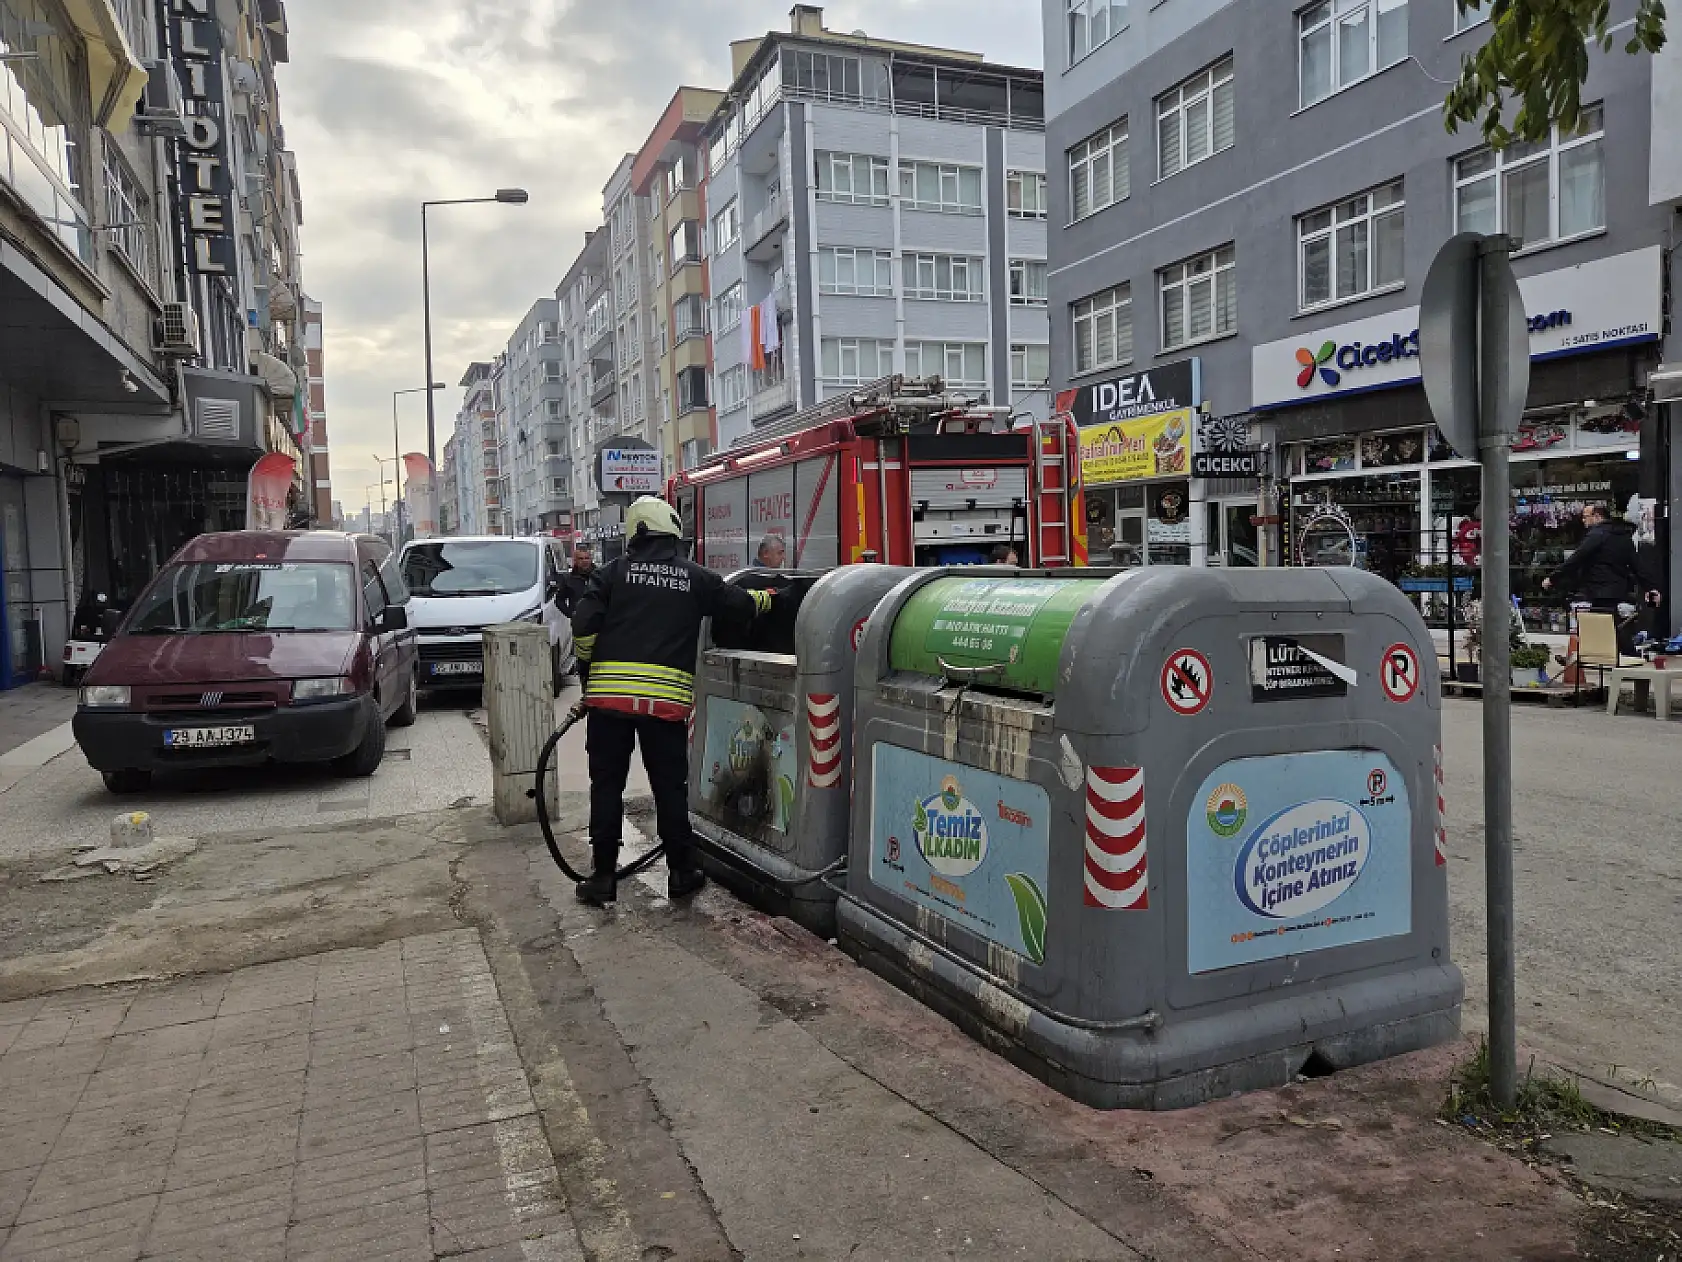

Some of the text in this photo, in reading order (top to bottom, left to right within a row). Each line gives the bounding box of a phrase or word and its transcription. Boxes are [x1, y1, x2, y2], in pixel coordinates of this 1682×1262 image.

[1092, 373, 1156, 413] IDEA
[630, 562, 689, 579] SAMSUN
[926, 808, 983, 840] Temiz
[1258, 811, 1350, 863] Çöplerinizi
[923, 833, 980, 862] İLKADIM
[1253, 835, 1359, 887] Konteynerin
[1261, 860, 1358, 910] İçine Atınız
